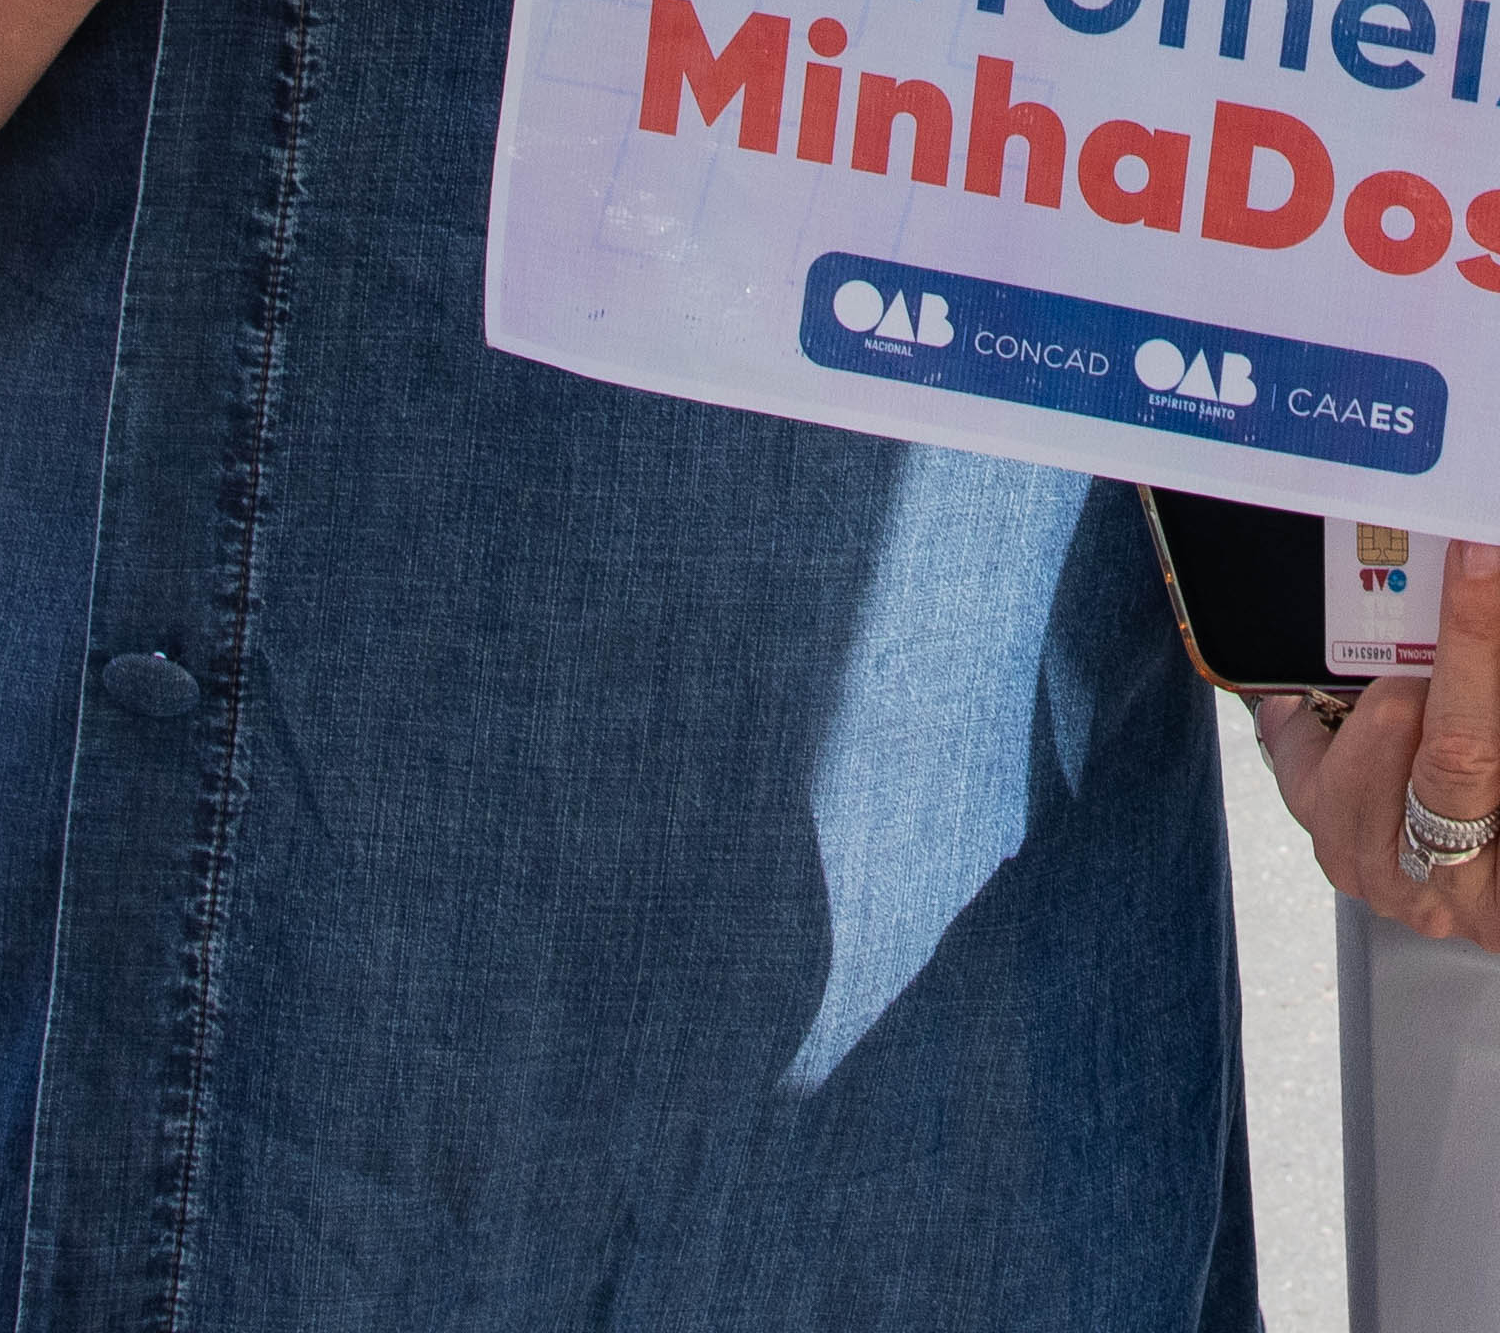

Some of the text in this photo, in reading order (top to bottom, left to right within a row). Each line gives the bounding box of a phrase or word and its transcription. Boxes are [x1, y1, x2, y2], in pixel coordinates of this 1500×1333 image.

[833, 279, 1110, 377] OAB CONCAD
[864, 337, 914, 358] NACIONAL
[1134, 338, 1415, 435] OAB CAAES
[1148, 393, 1236, 421] ESPÍRITO SANTO
